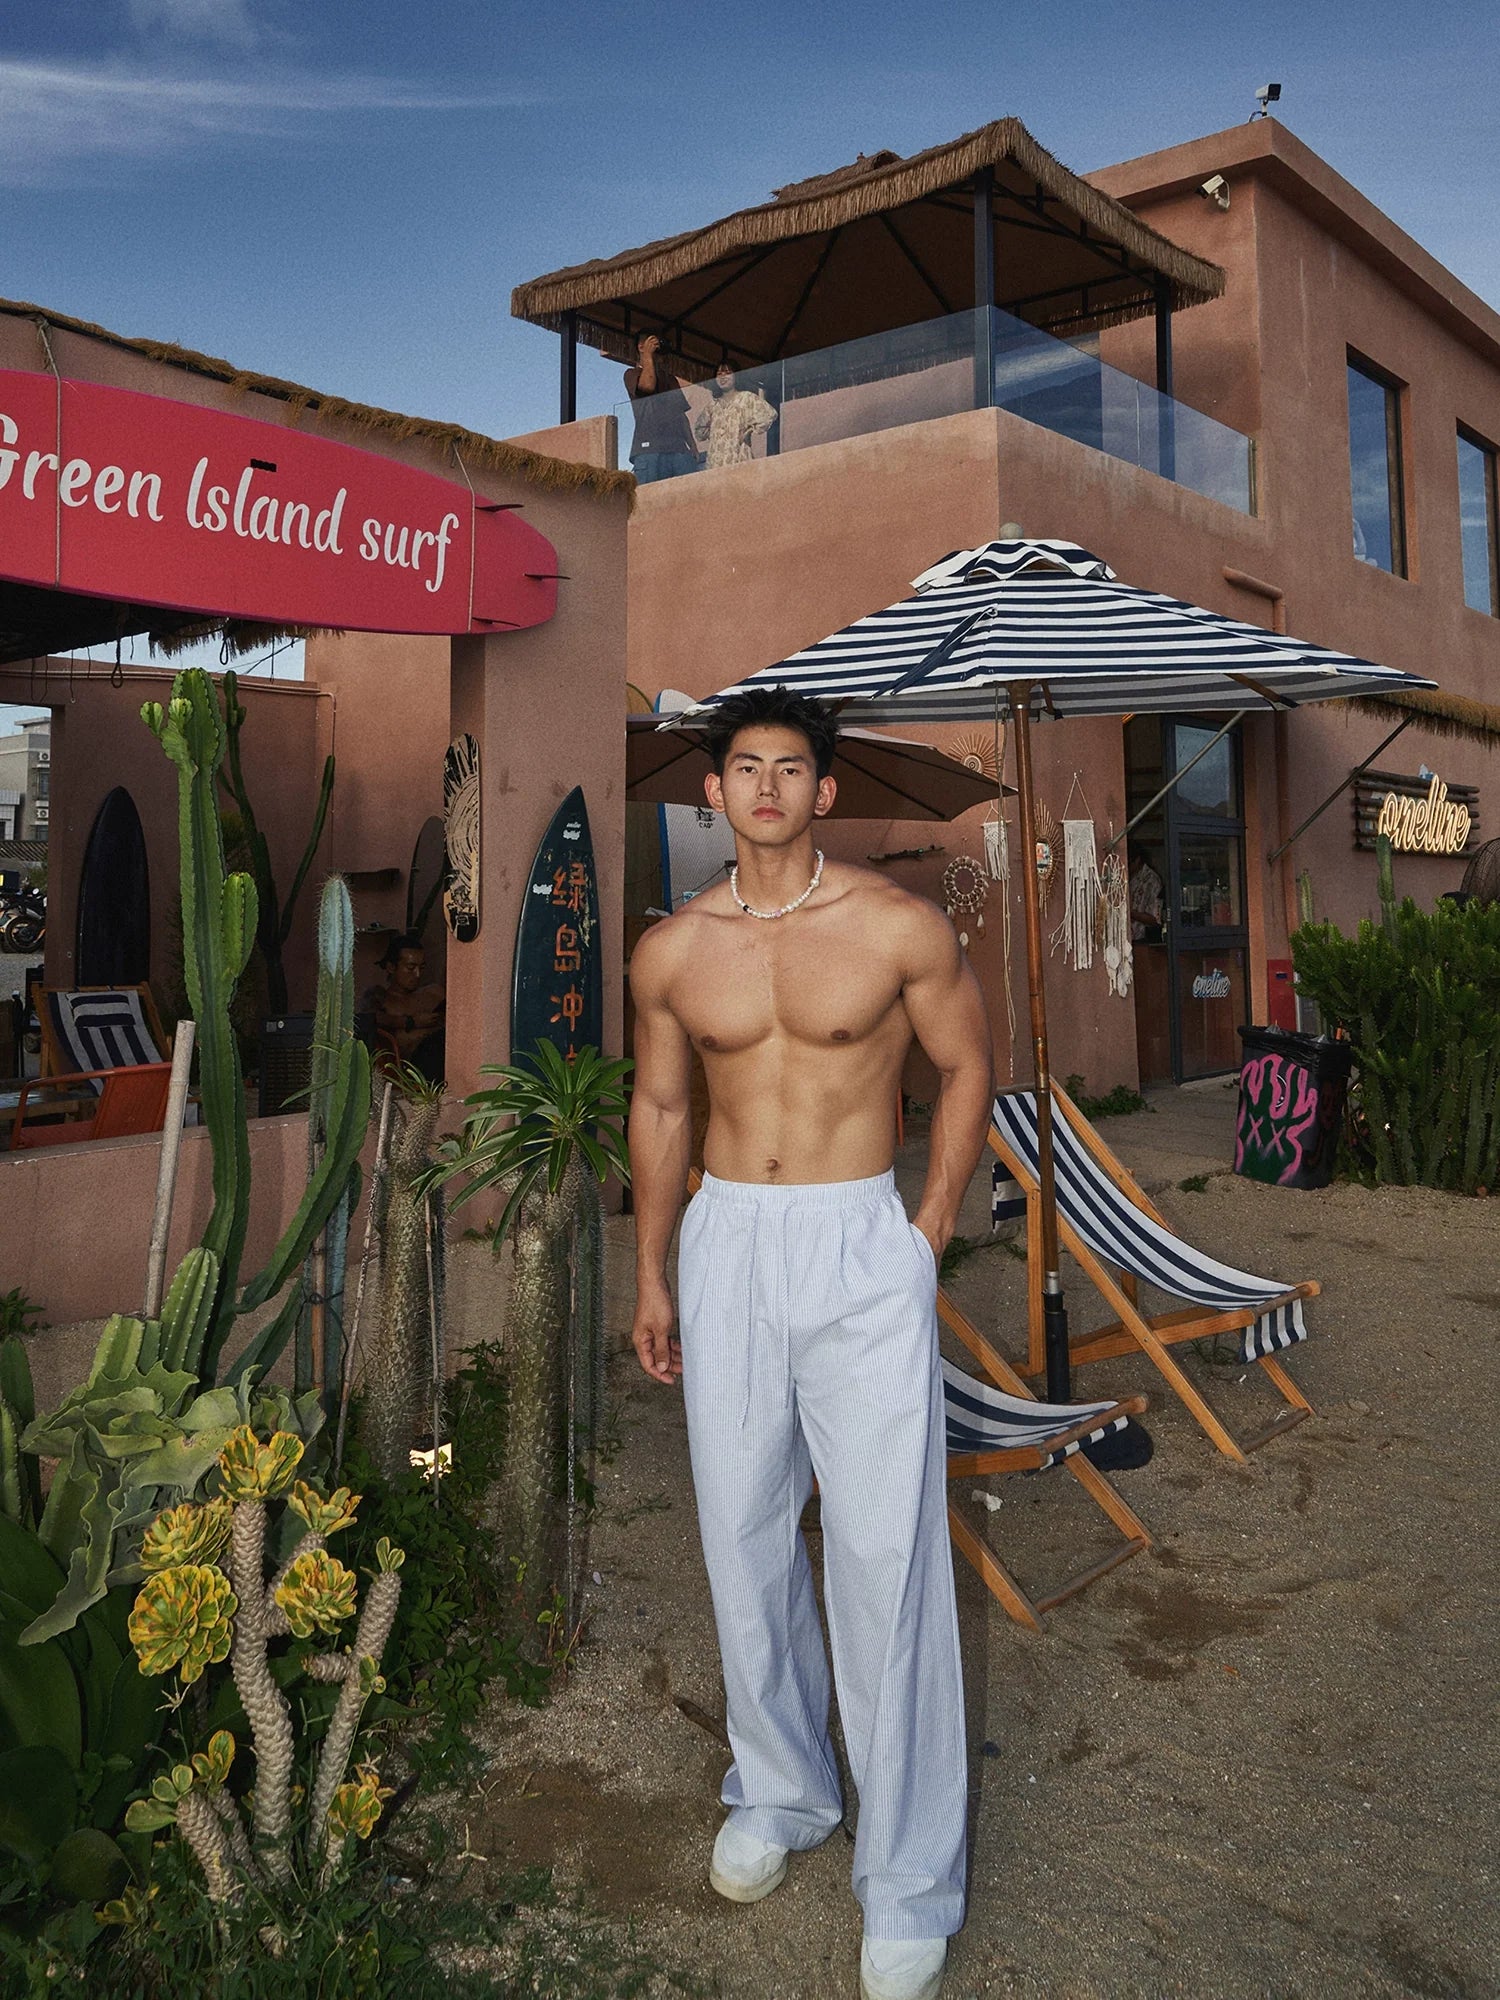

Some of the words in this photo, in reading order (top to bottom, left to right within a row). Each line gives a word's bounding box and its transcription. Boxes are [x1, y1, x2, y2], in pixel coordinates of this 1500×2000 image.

[186, 456, 347, 555] Island
[359, 512, 459, 593] surf
[1378, 774, 1472, 854] oneline
[550, 862, 587, 1070] 绿岛冲
